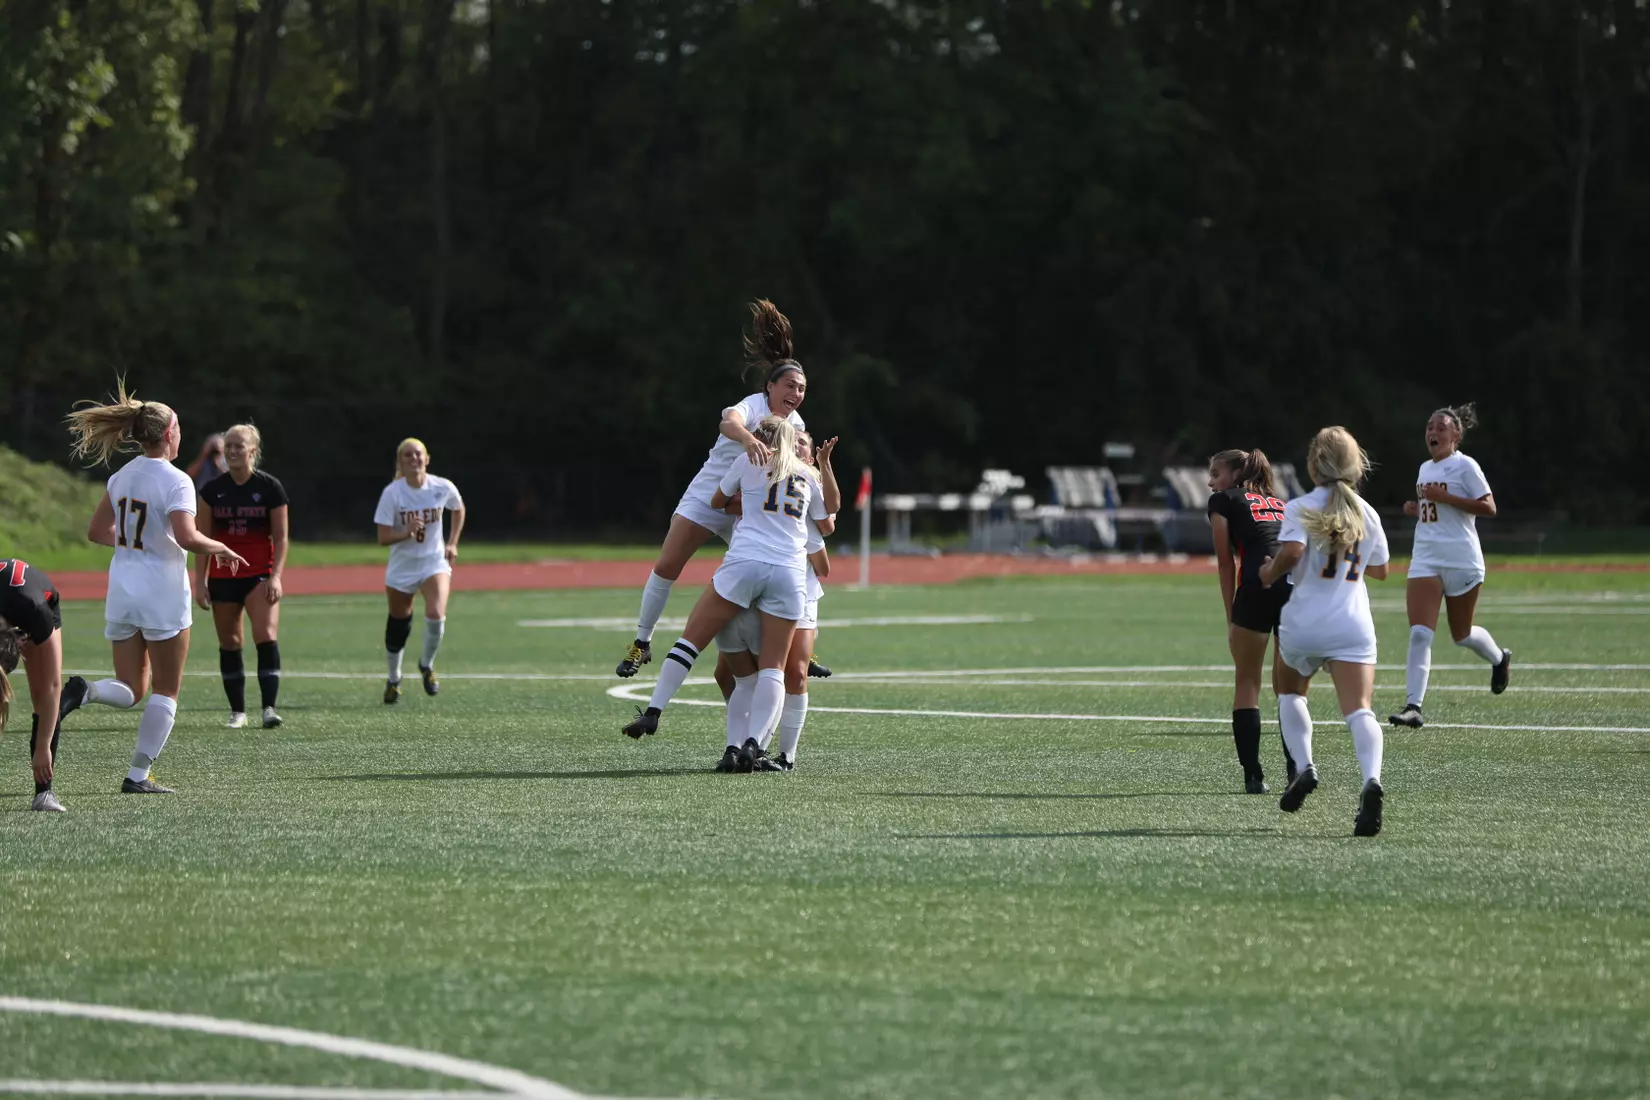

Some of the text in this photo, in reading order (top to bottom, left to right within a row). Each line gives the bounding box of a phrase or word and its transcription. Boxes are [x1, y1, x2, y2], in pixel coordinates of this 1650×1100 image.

[762, 471, 805, 519] 15
[117, 496, 148, 551] 17
[236, 505, 267, 518] STATE
[1421, 502, 1438, 523] 33
[0, 558, 29, 587] 1
